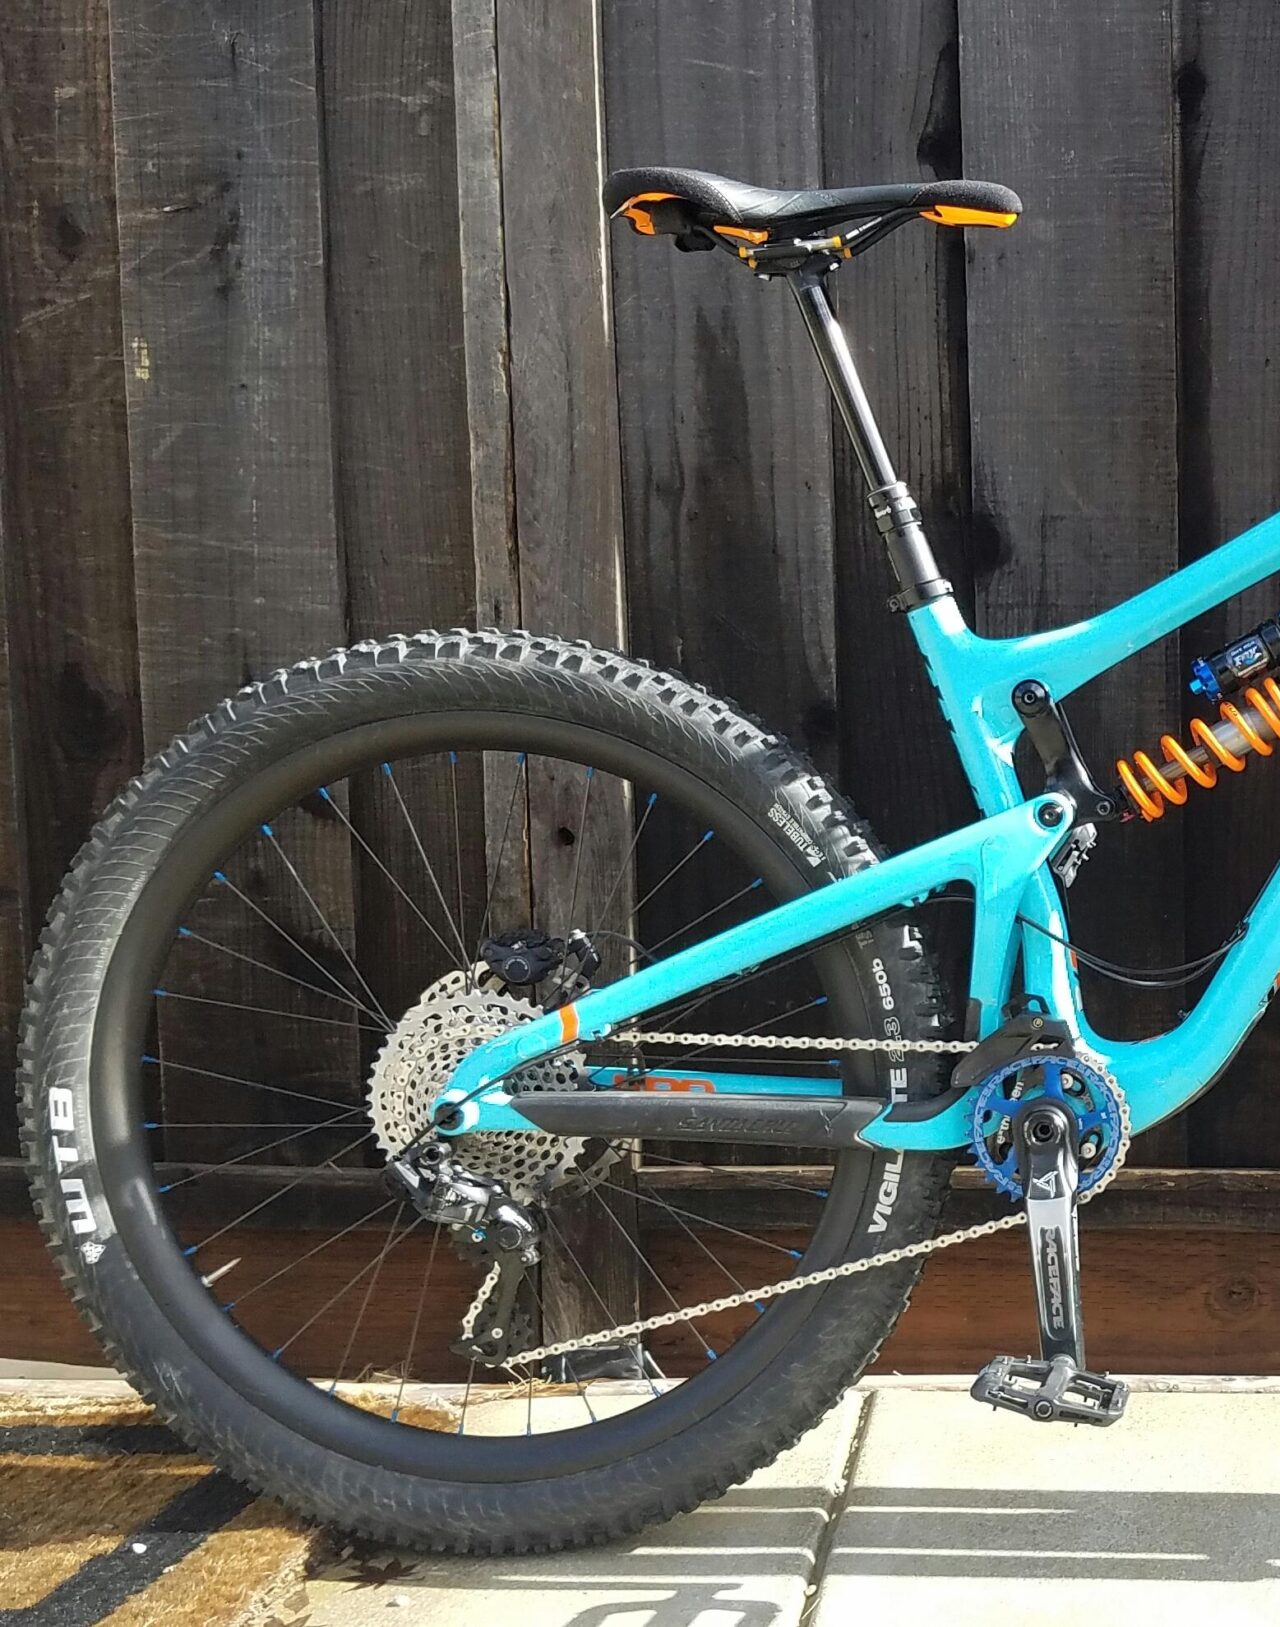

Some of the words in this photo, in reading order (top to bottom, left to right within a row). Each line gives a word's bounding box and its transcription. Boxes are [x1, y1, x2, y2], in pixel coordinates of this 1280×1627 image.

[768, 807, 808, 851] TUBELESS
[872, 957, 895, 1010] 650b
[48, 1086, 97, 1234] WTB
[1045, 1227, 1065, 1330] RACEFACE
